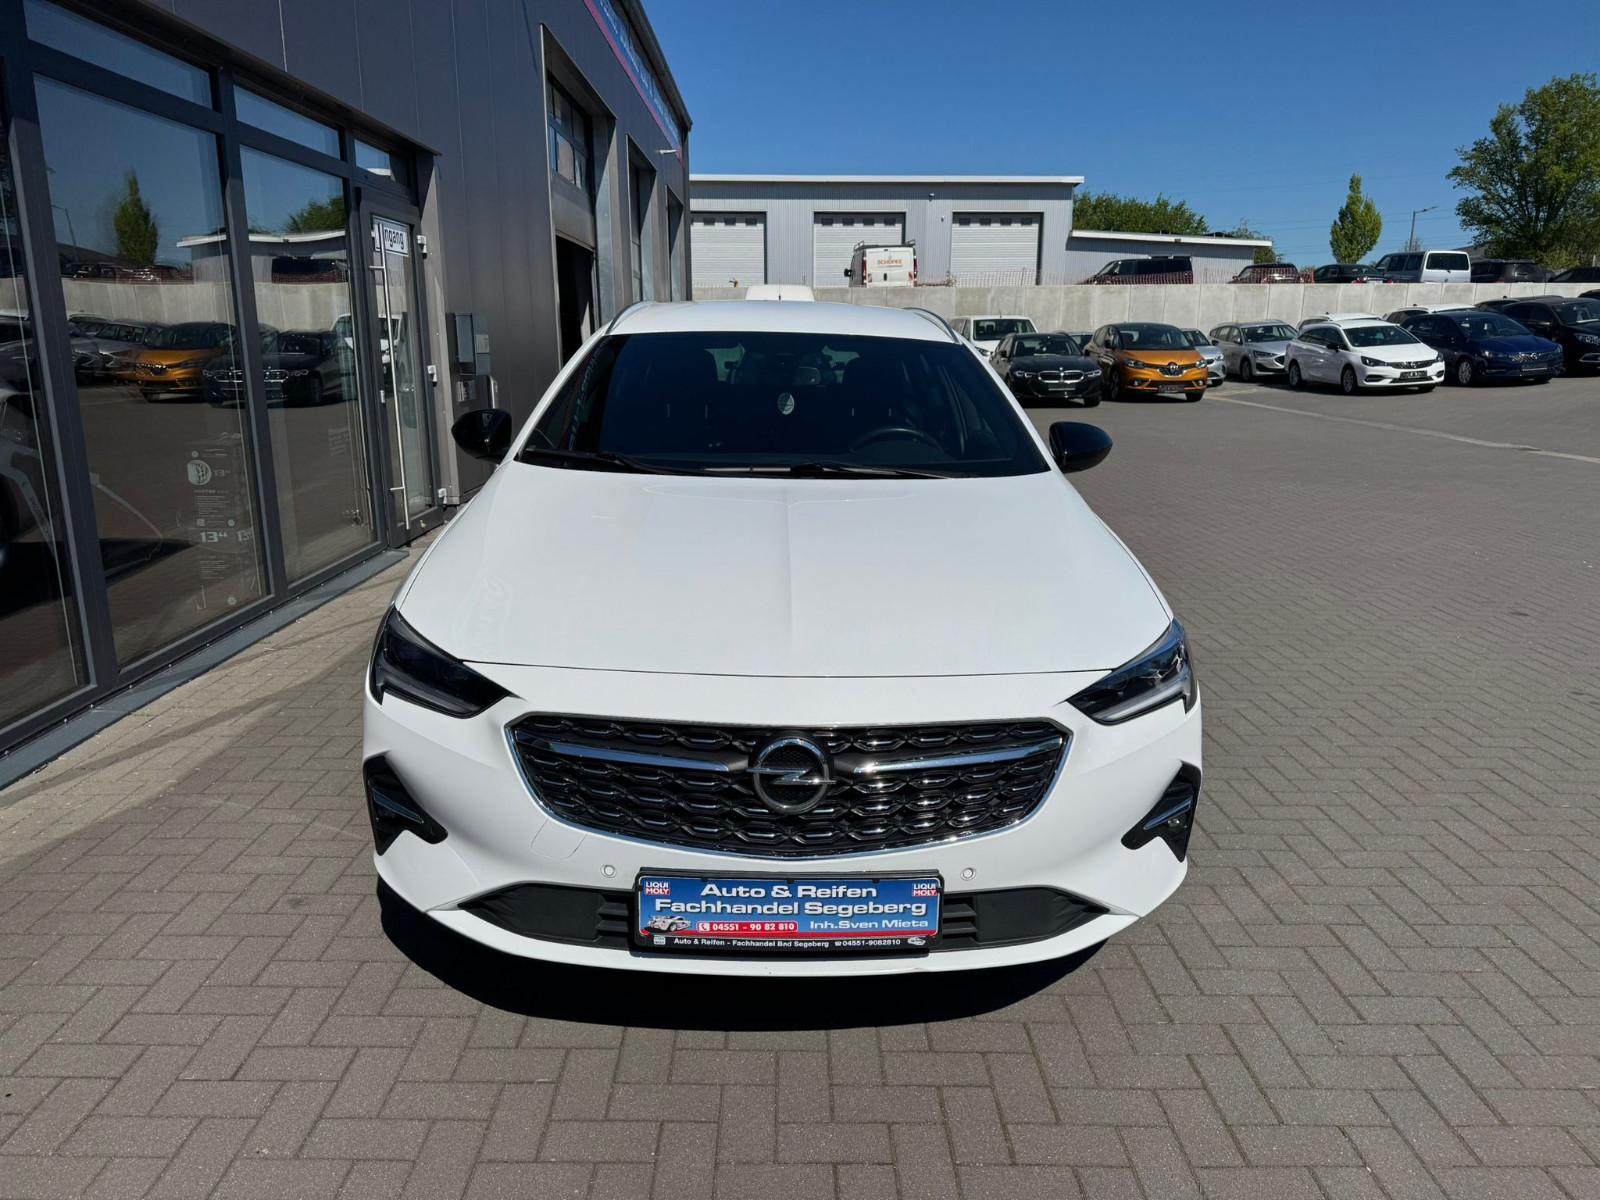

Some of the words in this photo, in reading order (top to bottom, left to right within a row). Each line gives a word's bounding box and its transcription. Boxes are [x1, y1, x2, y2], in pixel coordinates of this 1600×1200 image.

[701, 883, 766, 897] Auto
[771, 885, 793, 898] &
[797, 885, 877, 898] Reifen
[913, 889, 937, 897] MOLY
[655, 898, 799, 915] Fachhandel
[804, 901, 927, 918] Segeberg
[712, 922, 740, 931] 04551
[749, 923, 761, 931] 90
[764, 923, 776, 931] 82
[778, 923, 795, 931] 810
[881, 919, 929, 929] Mieta
[700, 938, 725, 946] Reifen
[732, 939, 776, 947] Fachhandel
[794, 940, 830, 949] Segeberg
